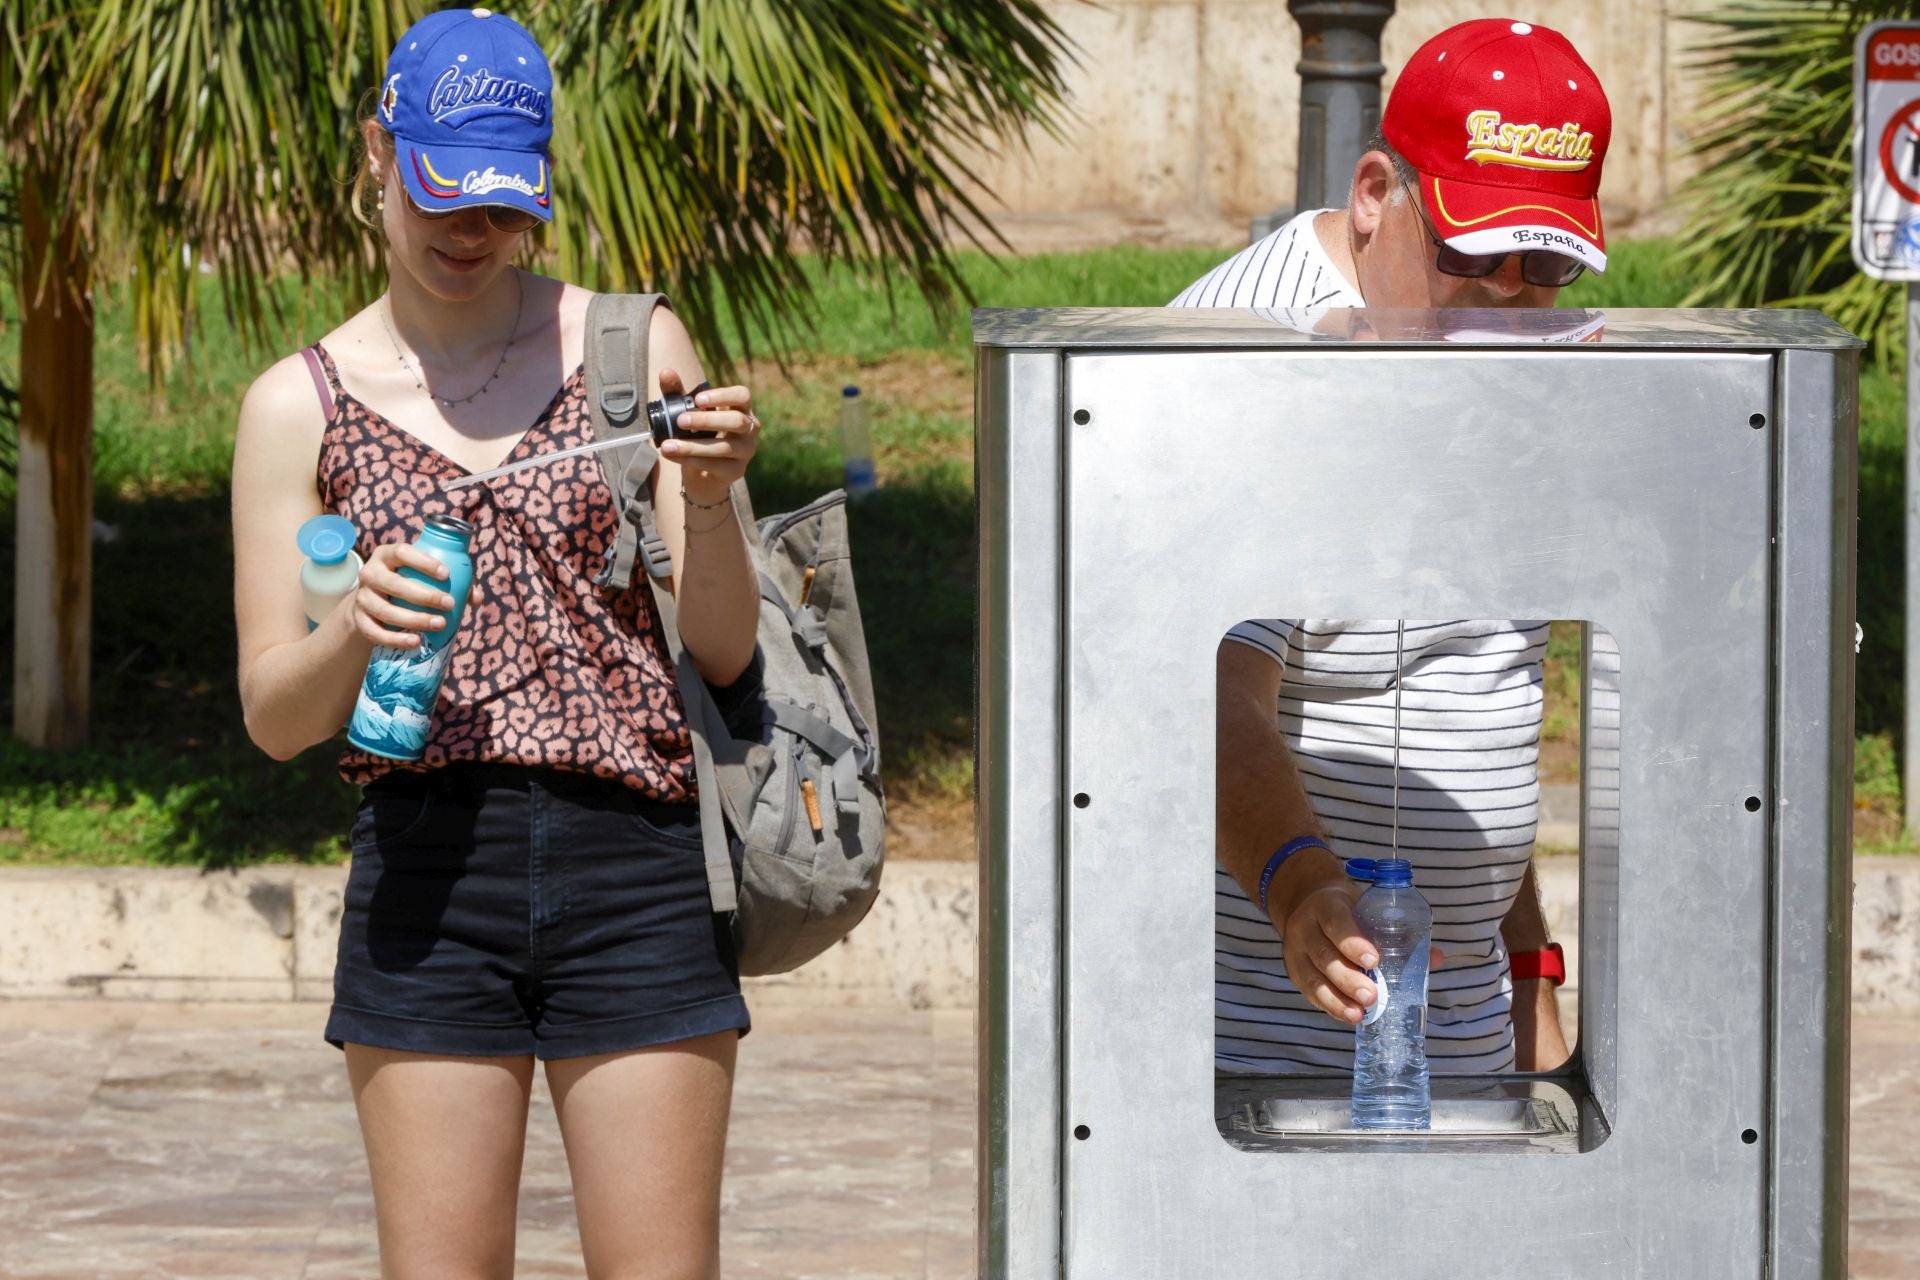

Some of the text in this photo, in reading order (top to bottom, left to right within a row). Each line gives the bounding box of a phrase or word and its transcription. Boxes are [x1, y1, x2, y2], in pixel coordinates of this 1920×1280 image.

[1466, 110, 1594, 160] España
[462, 166, 533, 194] Colombia
[1512, 229, 1586, 255] España
